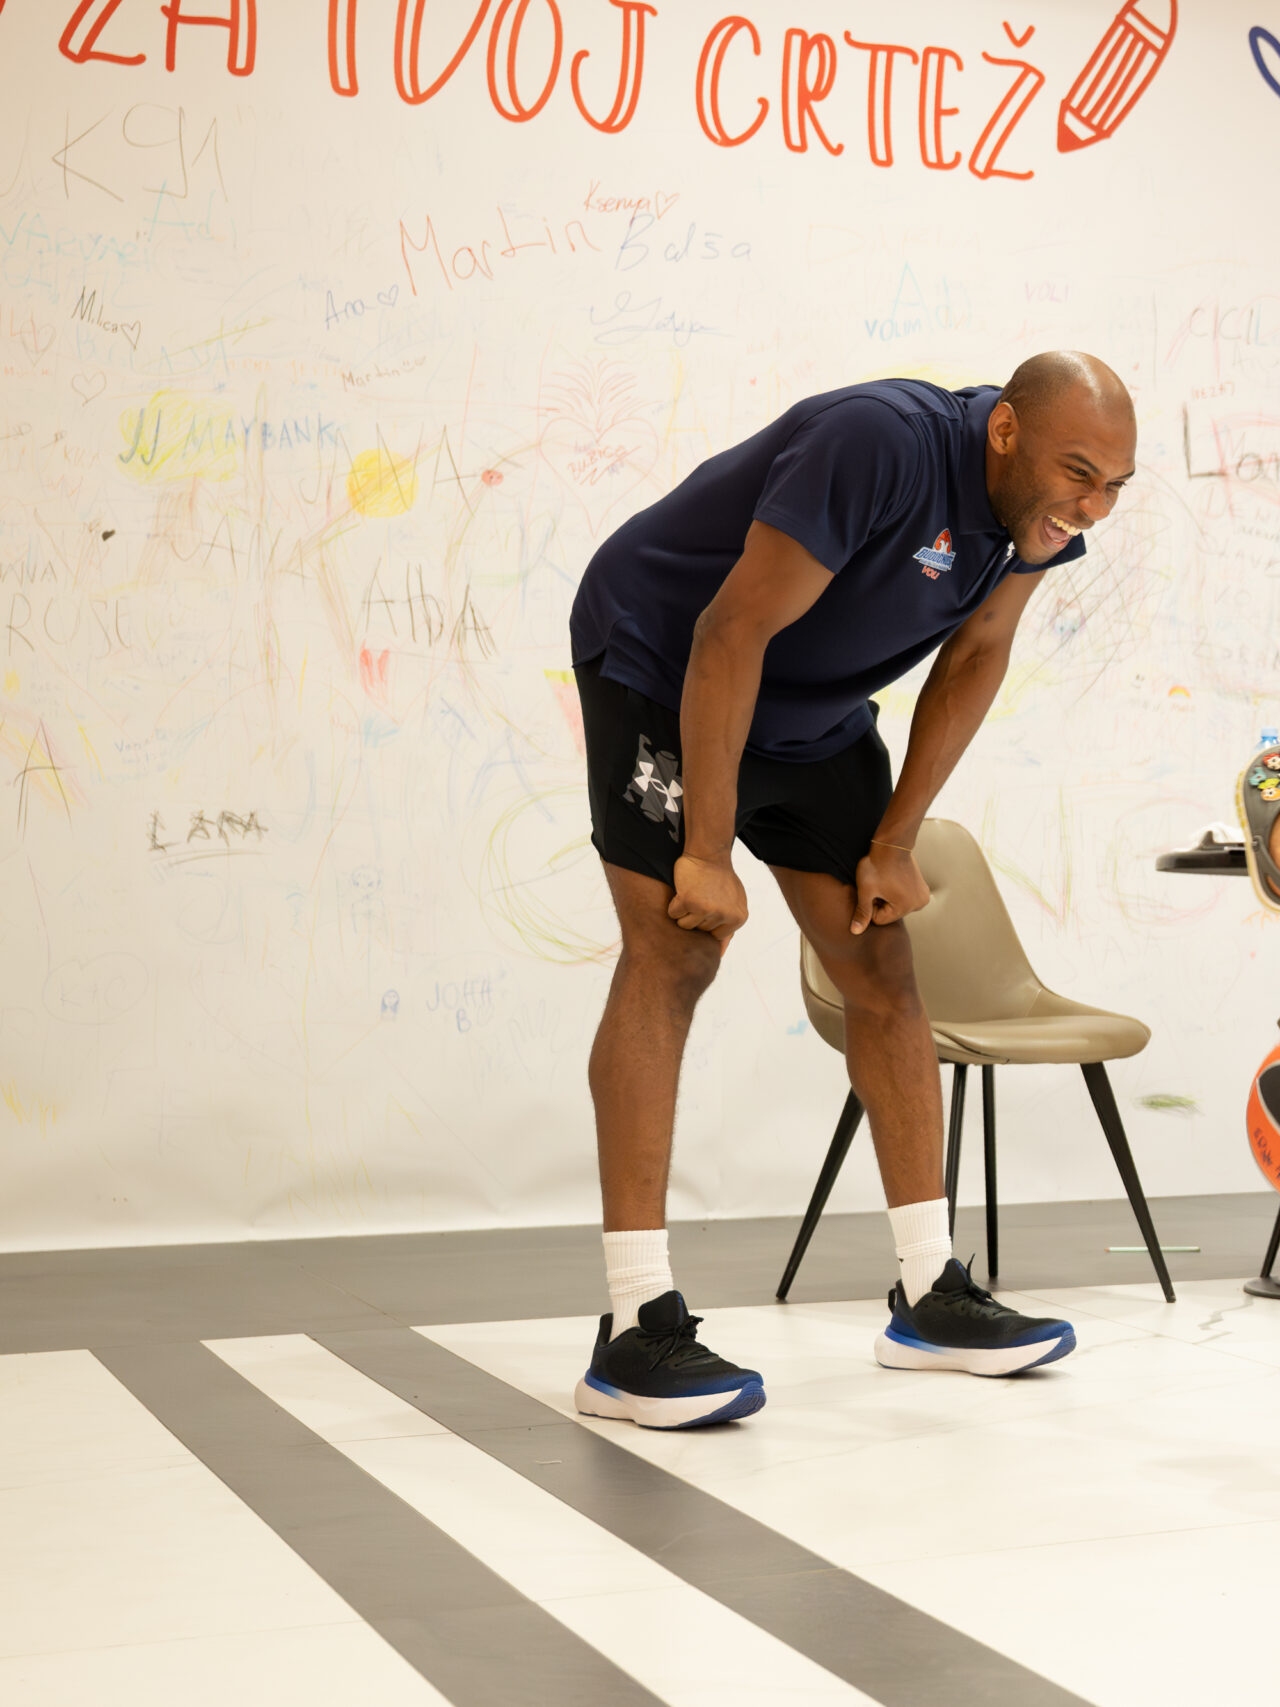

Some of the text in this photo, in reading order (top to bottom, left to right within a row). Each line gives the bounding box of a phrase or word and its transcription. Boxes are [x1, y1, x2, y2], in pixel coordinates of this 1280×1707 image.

[696, 16, 1046, 180] CRTEŽ
[399, 205, 603, 297] Martin
[324, 289, 377, 331] Ana
